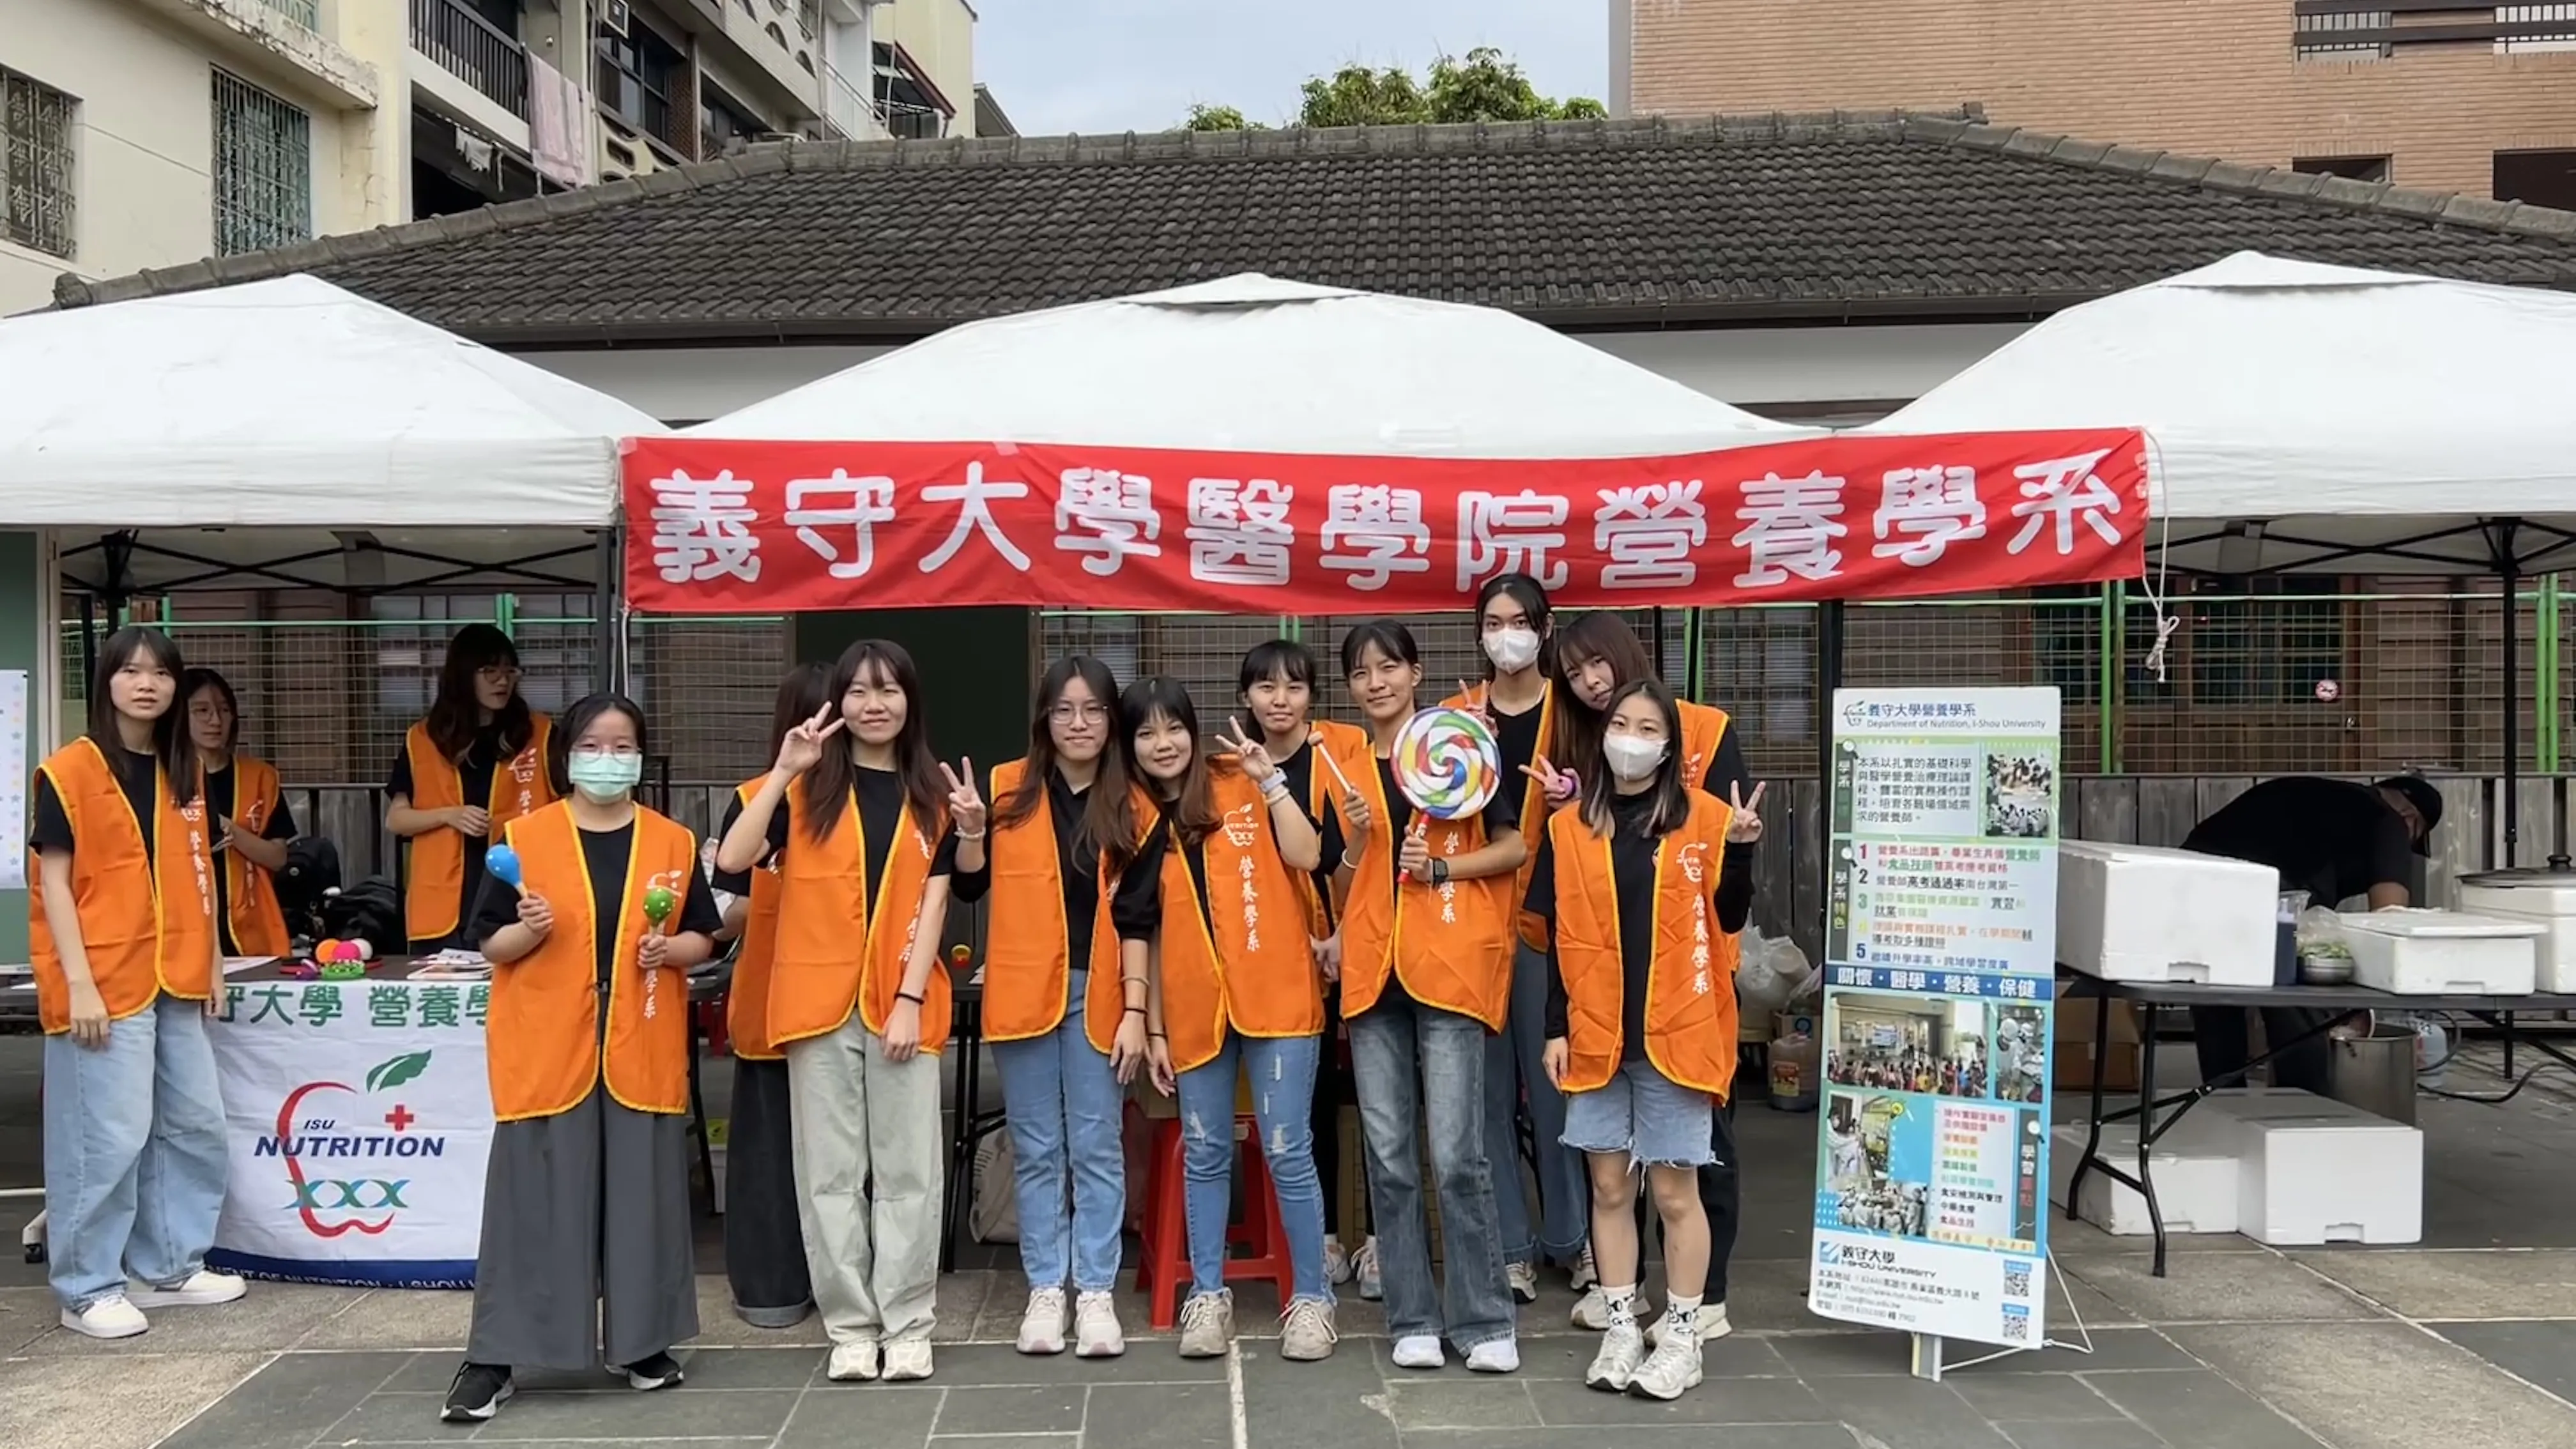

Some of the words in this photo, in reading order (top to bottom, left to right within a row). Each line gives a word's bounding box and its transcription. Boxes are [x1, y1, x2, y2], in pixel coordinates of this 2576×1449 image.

[649, 448, 2121, 593] 義守大學醫學院營養學系
[1867, 703, 1977, 717] 義守大學營養學系
[1867, 719, 1917, 728] Department
[1919, 719, 1928, 728] of
[2002, 719, 2046, 729] University
[1859, 843, 1867, 859] 1
[1859, 868, 1868, 884] 2
[1238, 855, 1260, 952] 營養學系
[1858, 894, 1867, 909] 3
[1856, 942, 1866, 958] 5
[303, 1118, 335, 1130] ISU
[254, 1135, 445, 1158] NUTRITION
